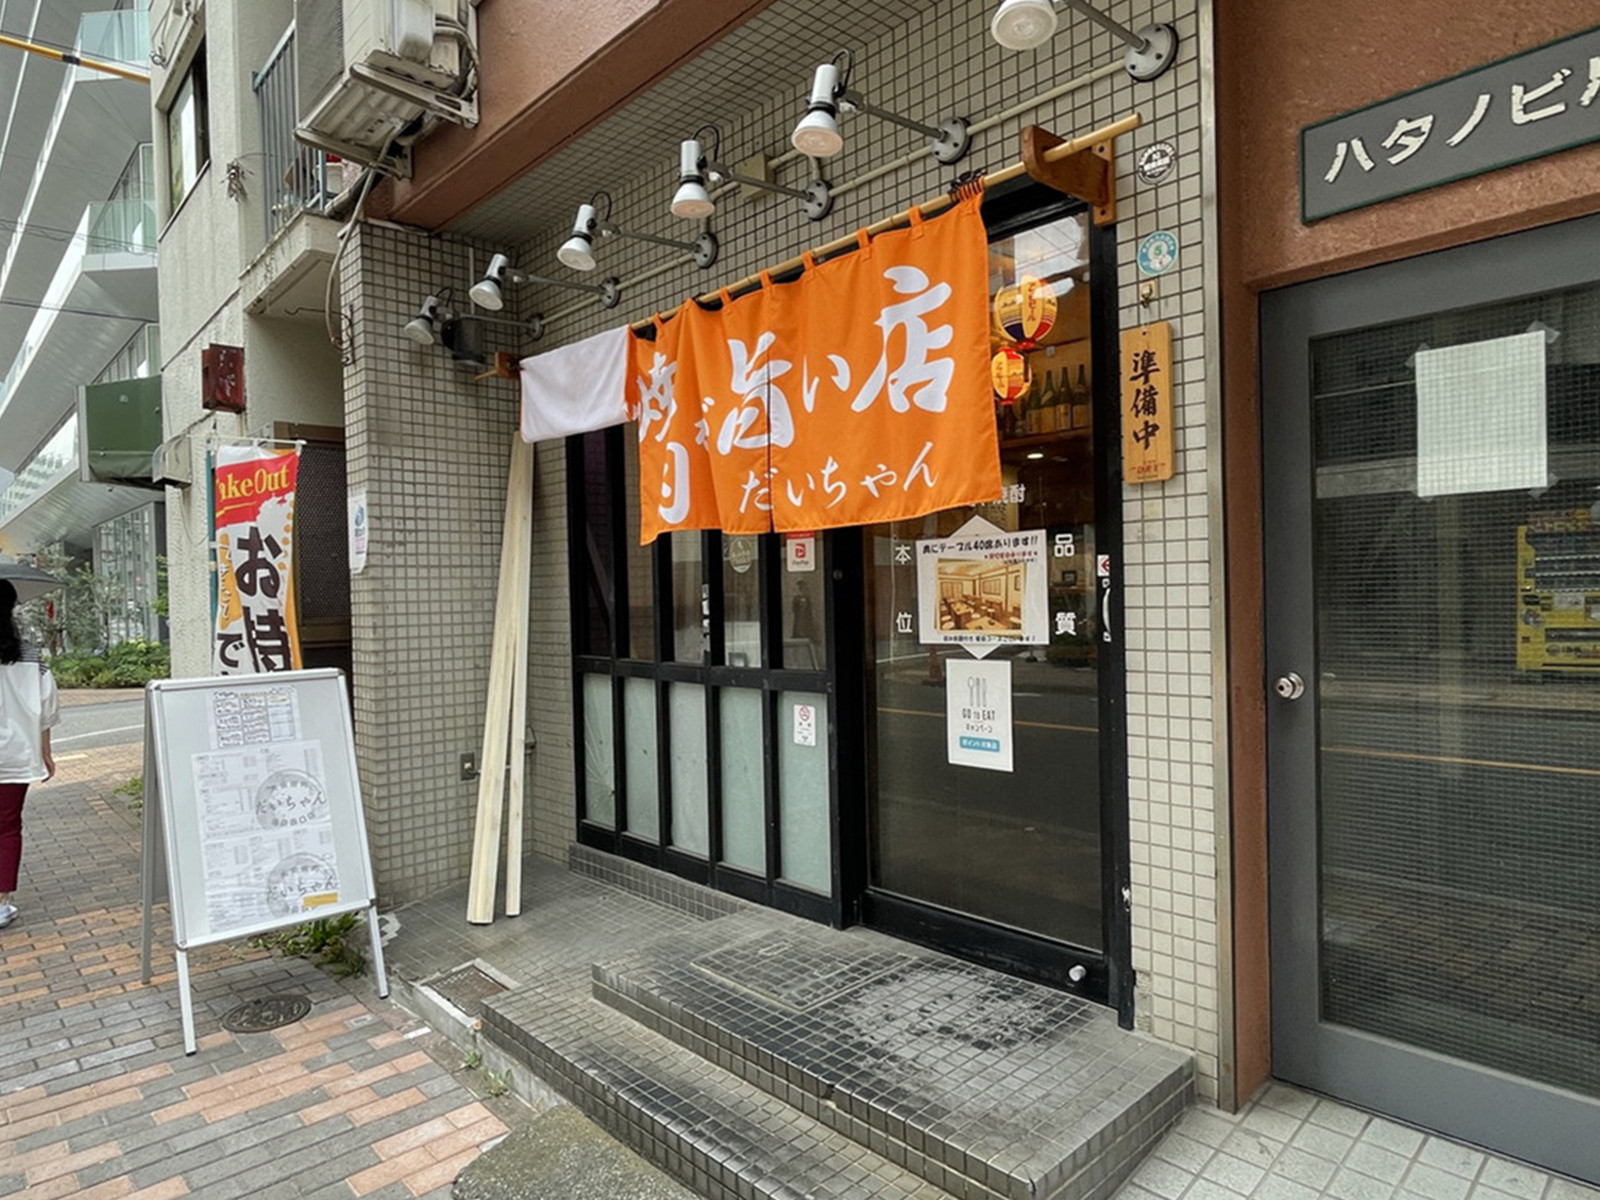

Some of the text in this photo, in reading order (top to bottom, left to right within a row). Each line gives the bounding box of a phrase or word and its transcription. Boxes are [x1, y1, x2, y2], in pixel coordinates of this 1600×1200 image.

[1129, 350, 1161, 450] 準備中
[740, 442, 938, 513] だいちゃん
